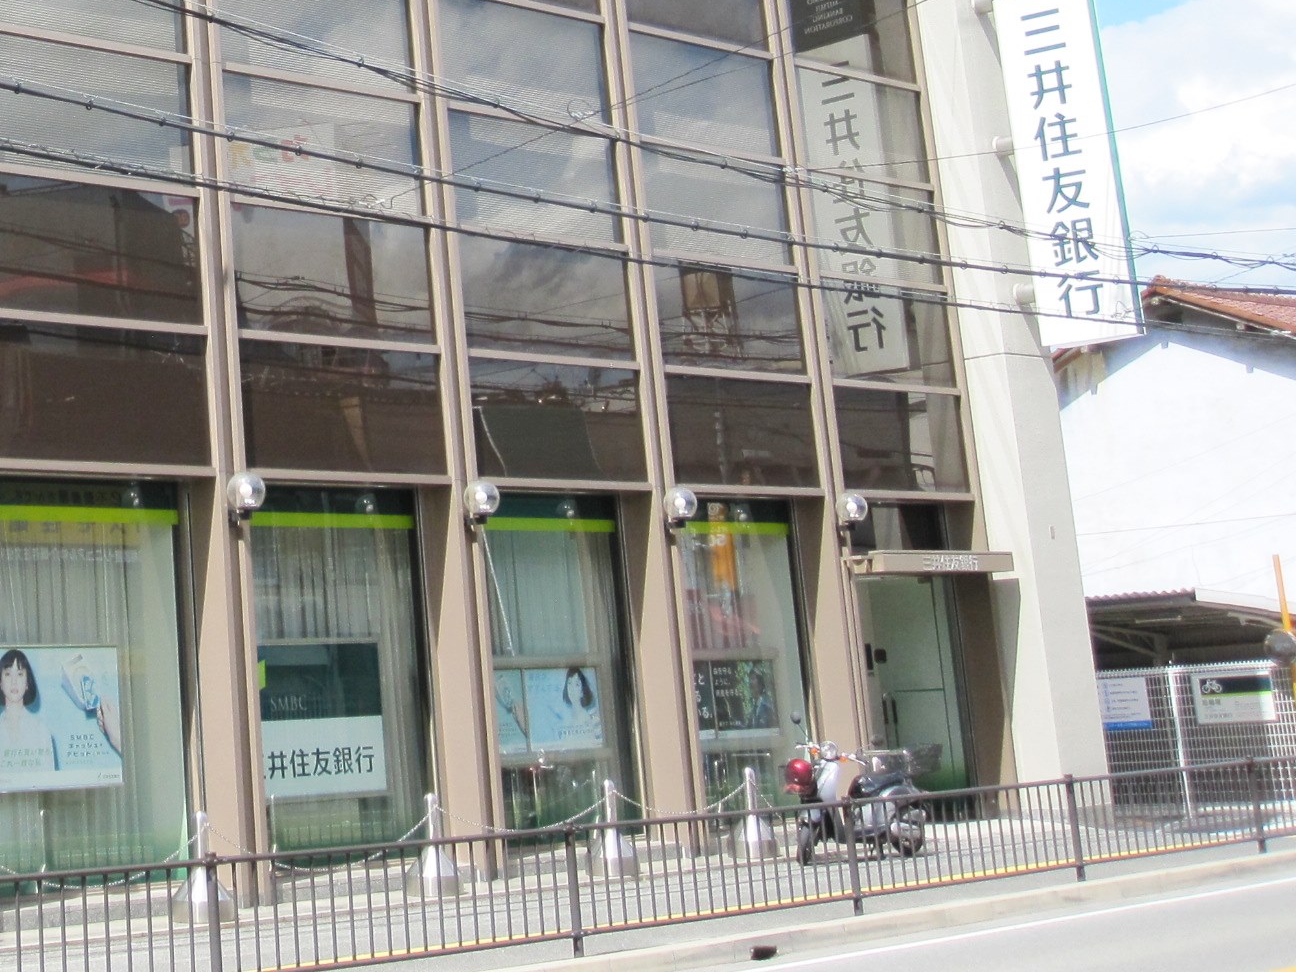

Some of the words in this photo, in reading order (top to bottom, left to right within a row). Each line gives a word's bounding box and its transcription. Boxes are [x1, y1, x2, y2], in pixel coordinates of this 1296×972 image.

[1020, 7, 1104, 319] 三井住友銀行
[264, 745, 375, 780] 井住友銀行
